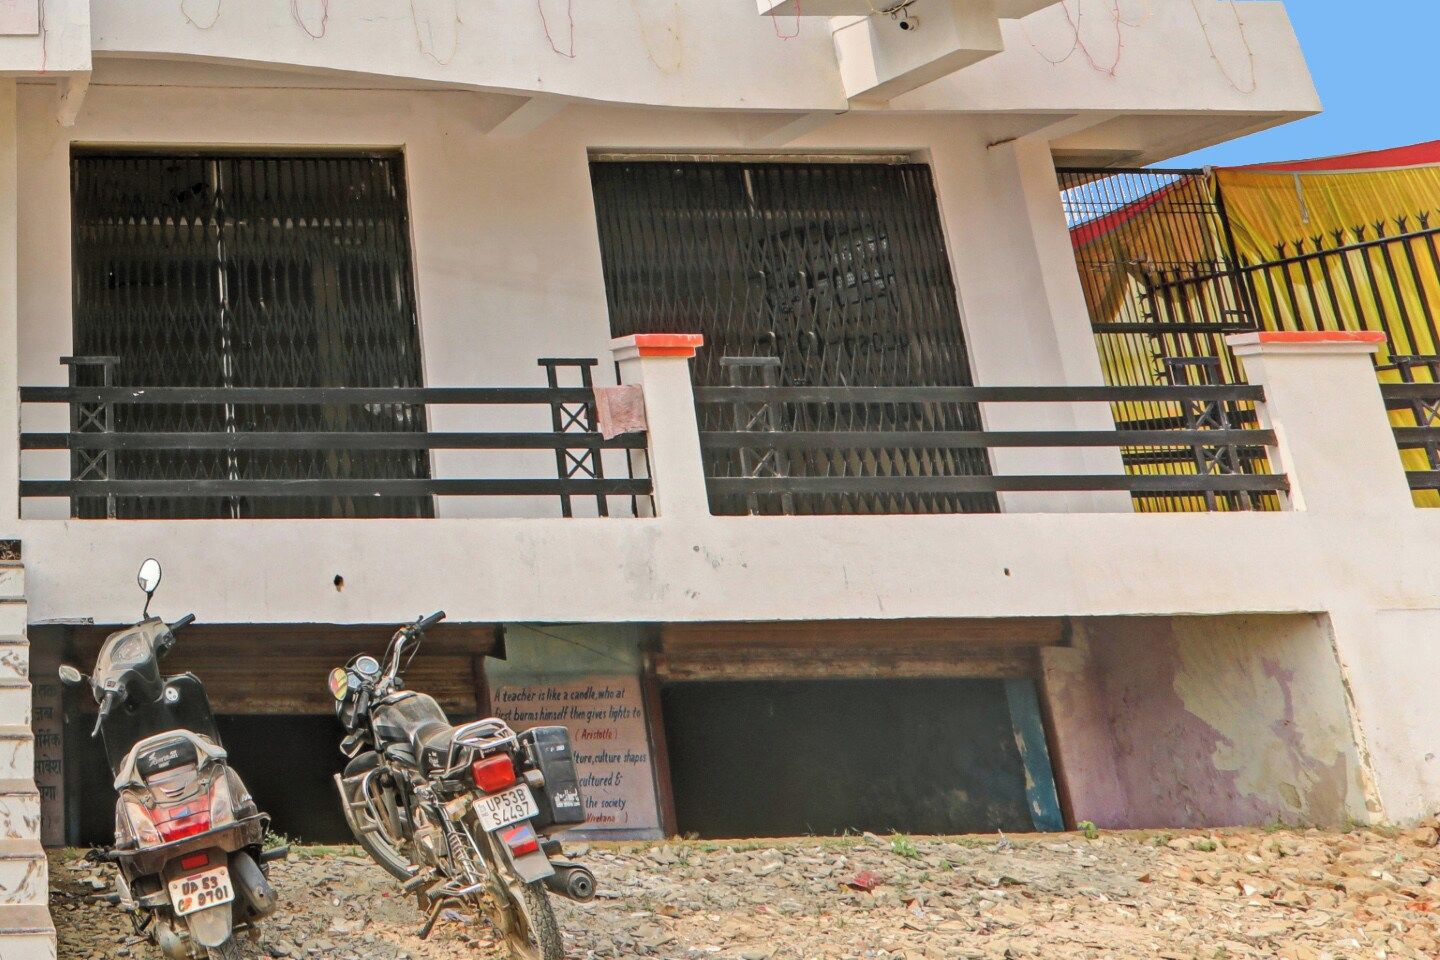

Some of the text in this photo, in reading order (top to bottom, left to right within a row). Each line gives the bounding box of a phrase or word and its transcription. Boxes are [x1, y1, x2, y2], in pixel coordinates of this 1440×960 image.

[494, 689, 501, 702] A
[503, 688, 536, 702] teacher
[546, 688, 561, 701] like
[539, 706, 569, 720] himself
[578, 771, 614, 787] cultured
[485, 788, 526, 812] UP53B
[585, 795, 598, 809] the
[601, 797, 627, 811] society
[492, 801, 529, 826] S4497
[201, 875, 218, 890] 53
